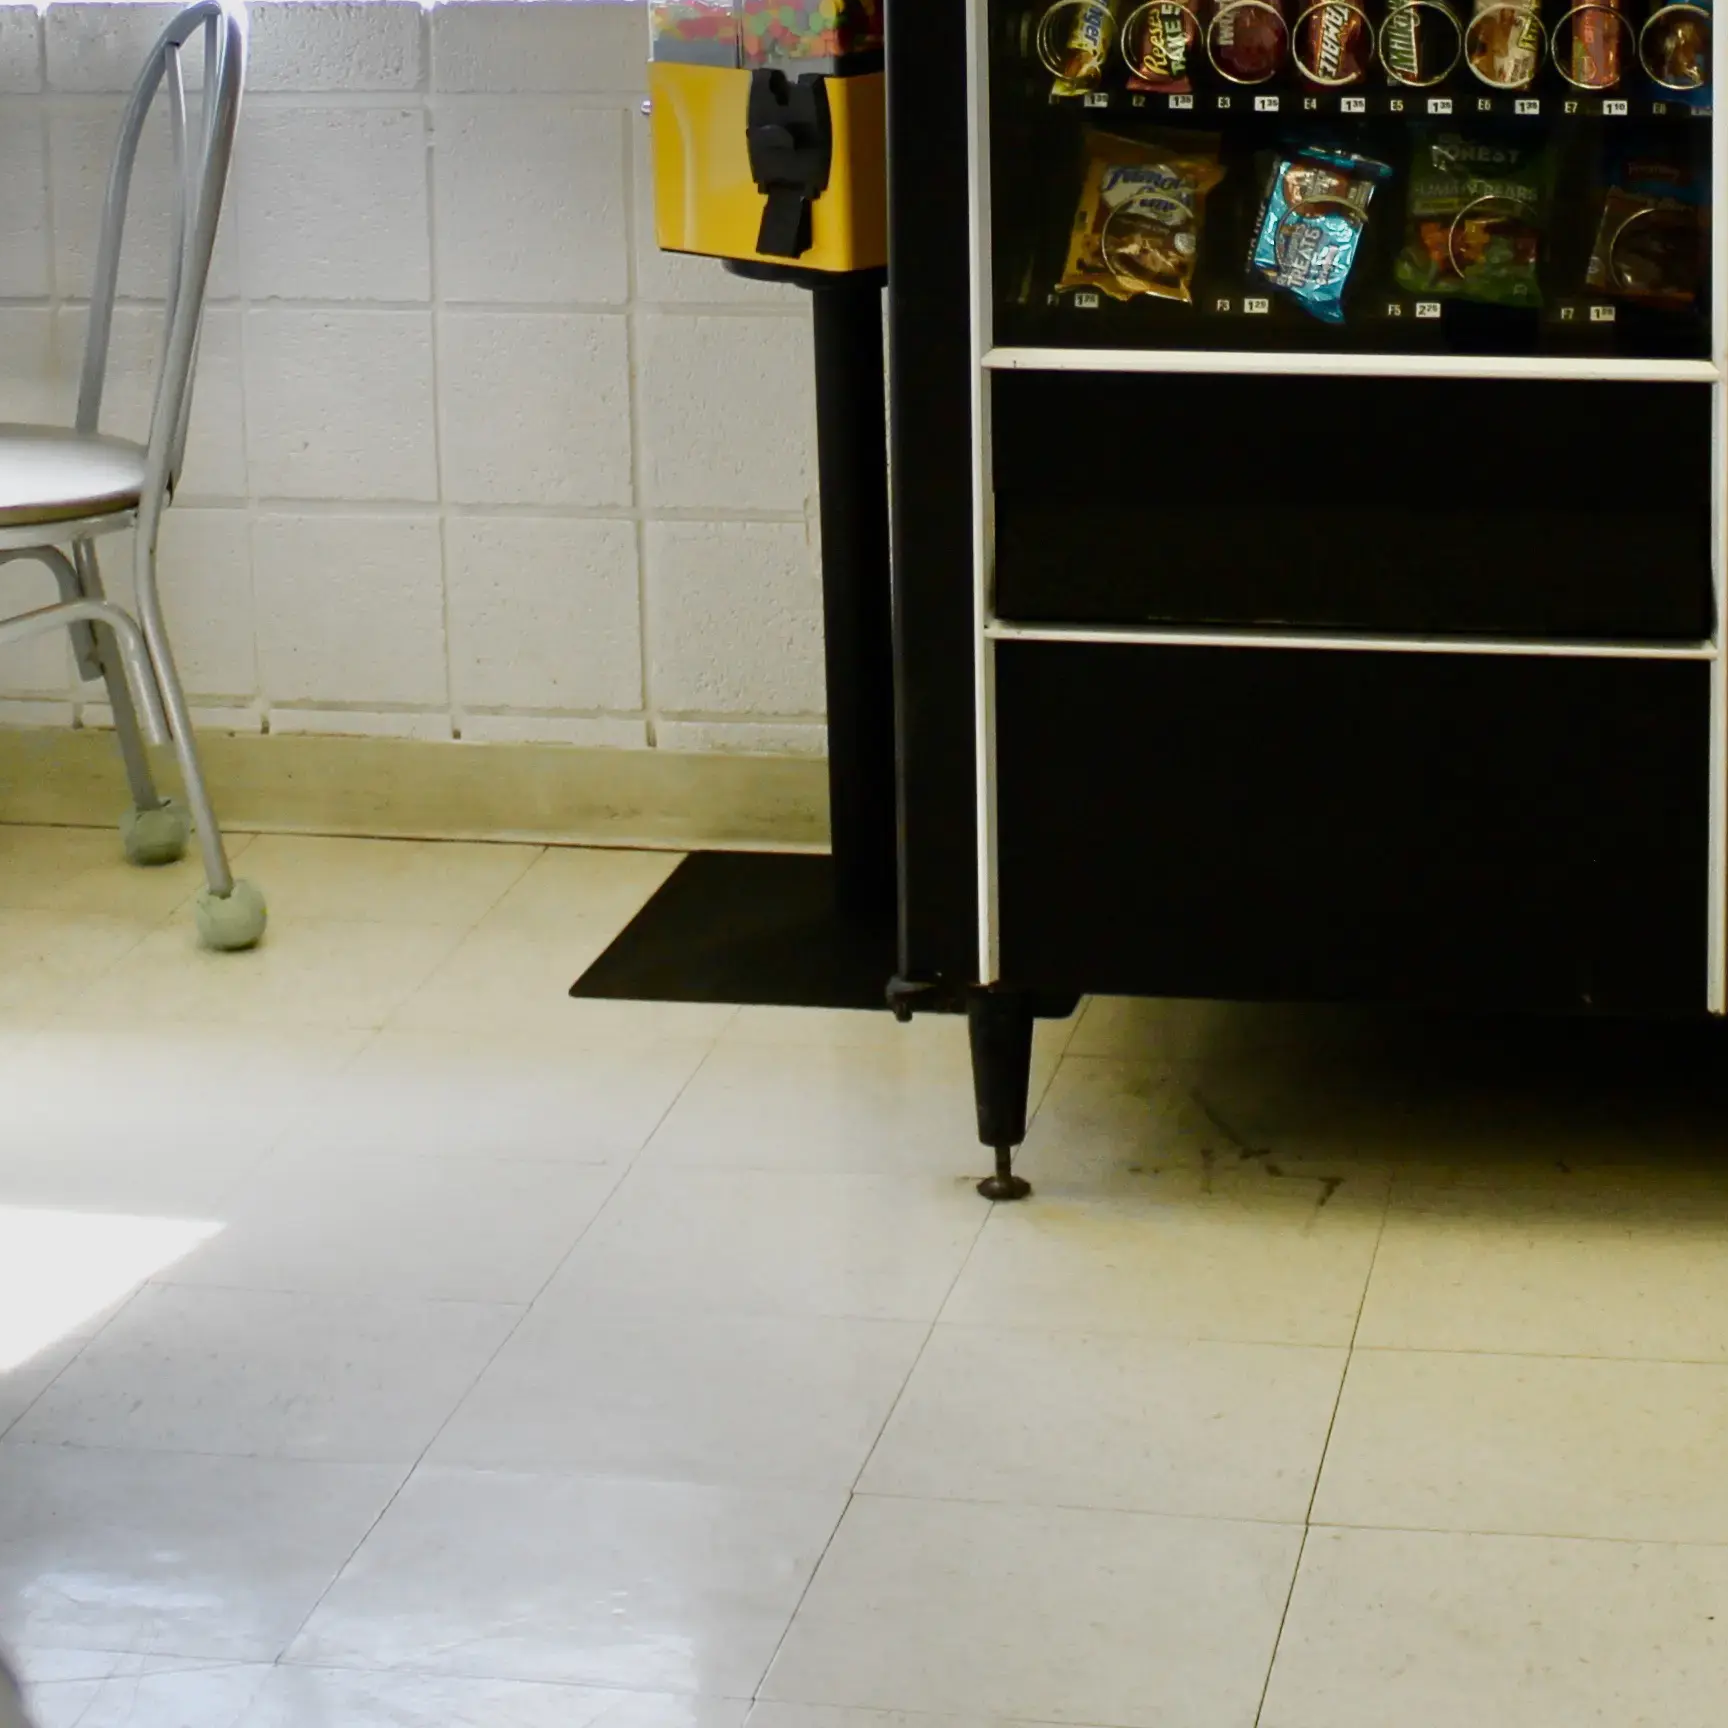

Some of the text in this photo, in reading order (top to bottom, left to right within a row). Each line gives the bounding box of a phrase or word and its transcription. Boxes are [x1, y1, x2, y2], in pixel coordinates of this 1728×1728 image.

[1304, 99, 1317, 110] E4
[1390, 100, 1403, 111] E5
[1478, 99, 1491, 110] E6
[1565, 102, 1578, 113] E7
[1388, 305, 1401, 316] F5
[1561, 308, 1574, 319] F7
